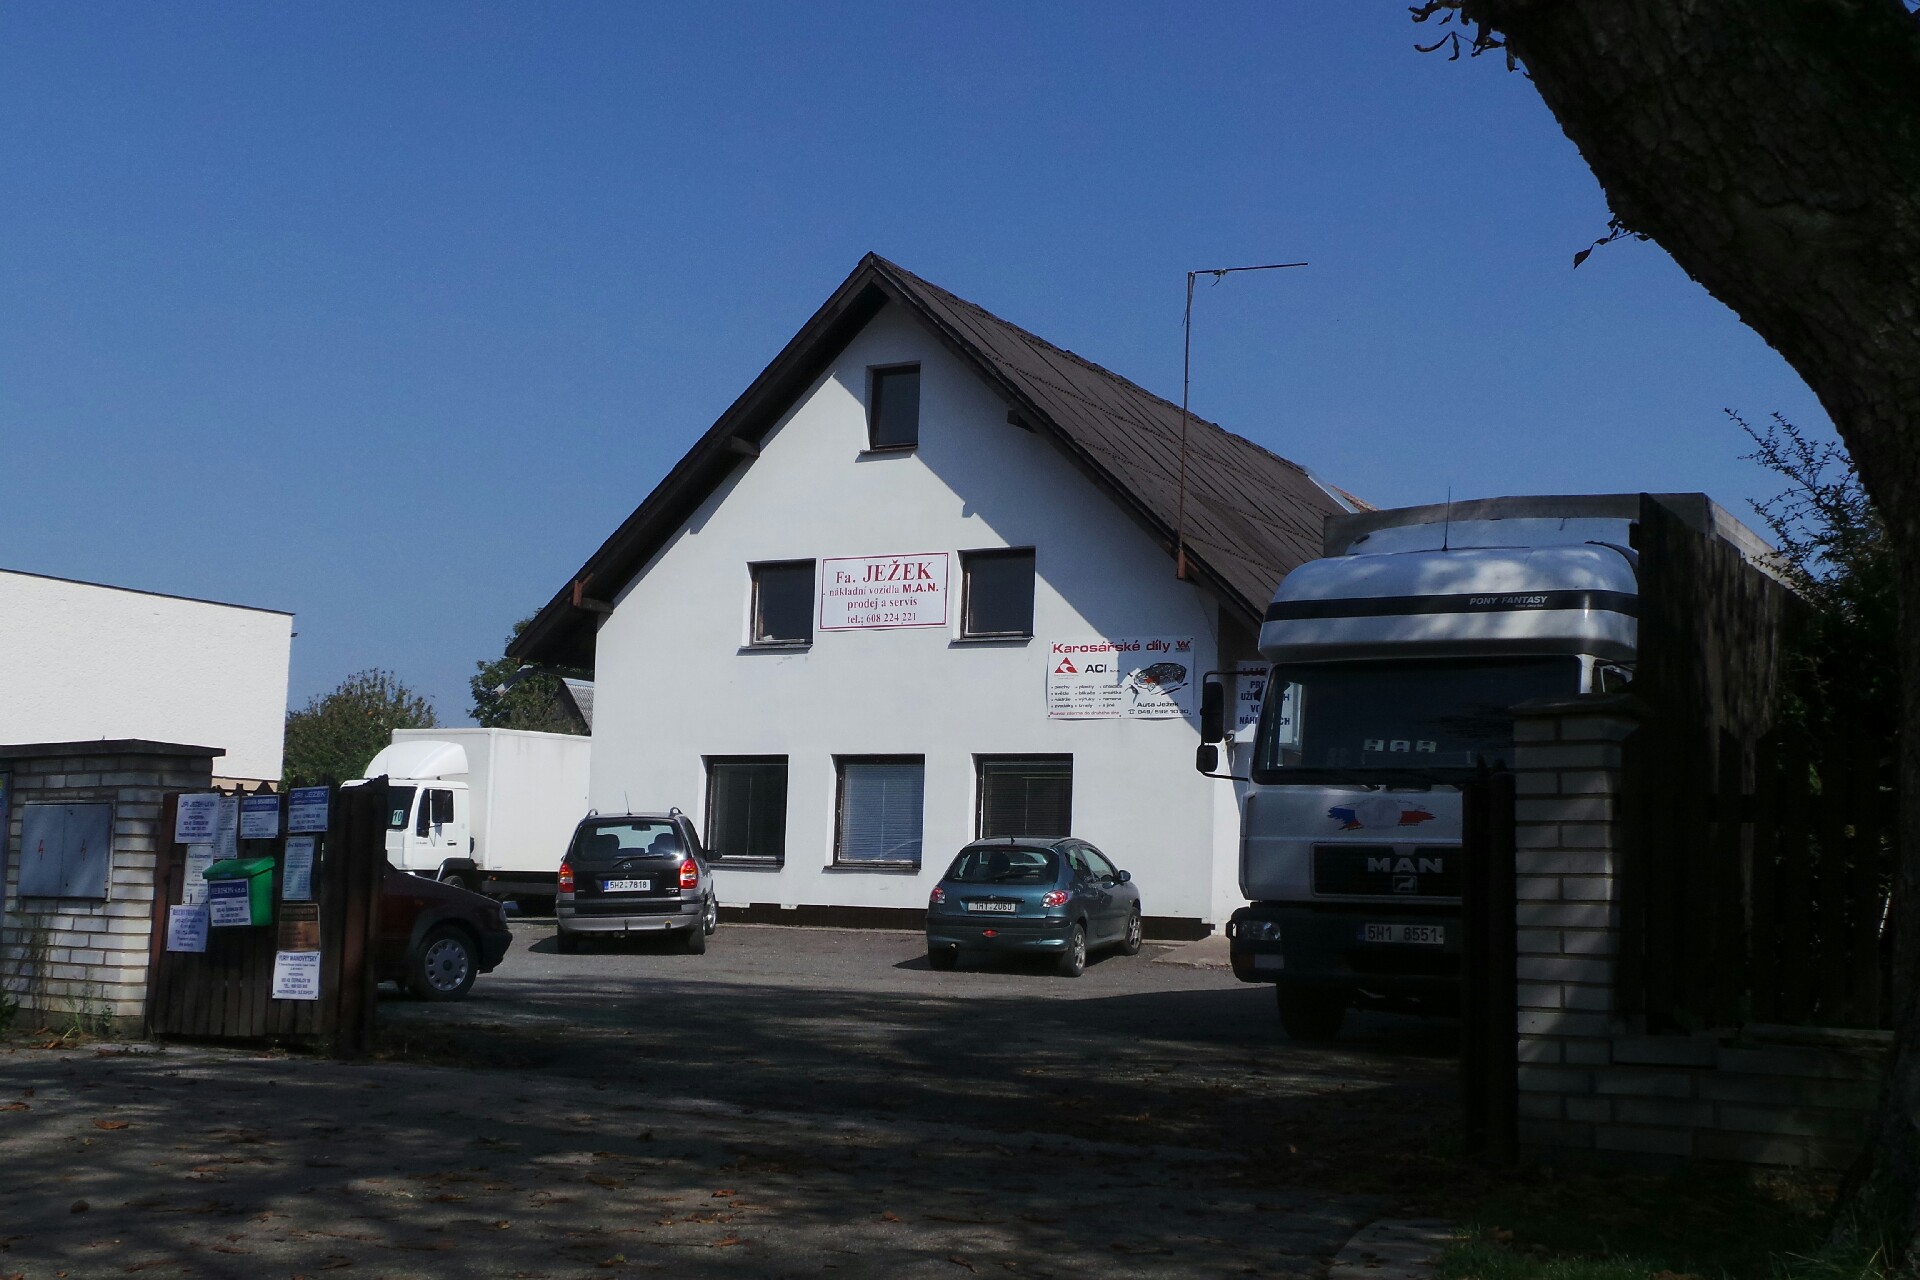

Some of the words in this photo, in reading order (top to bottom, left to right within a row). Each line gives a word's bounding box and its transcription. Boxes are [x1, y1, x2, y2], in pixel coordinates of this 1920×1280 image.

[836, 571, 856, 583] Fa.
[862, 560, 933, 582] JEŽEK
[902, 583, 939, 593] M.A.N.
[847, 598, 878, 611] prodej
[889, 597, 917, 606] servis
[1470, 597, 1498, 605] PONY
[866, 614, 880, 623] 608
[884, 613, 899, 622] 224
[902, 612, 916, 621] 221
[1053, 640, 1140, 653] Karosářské
[1146, 639, 1170, 653] díly
[1085, 664, 1107, 673] ACI
[393, 811, 402, 821] 10
[1368, 857, 1443, 873] MAN
[1368, 926, 1392, 940] 5H1
[1404, 927, 1437, 942] 8551
